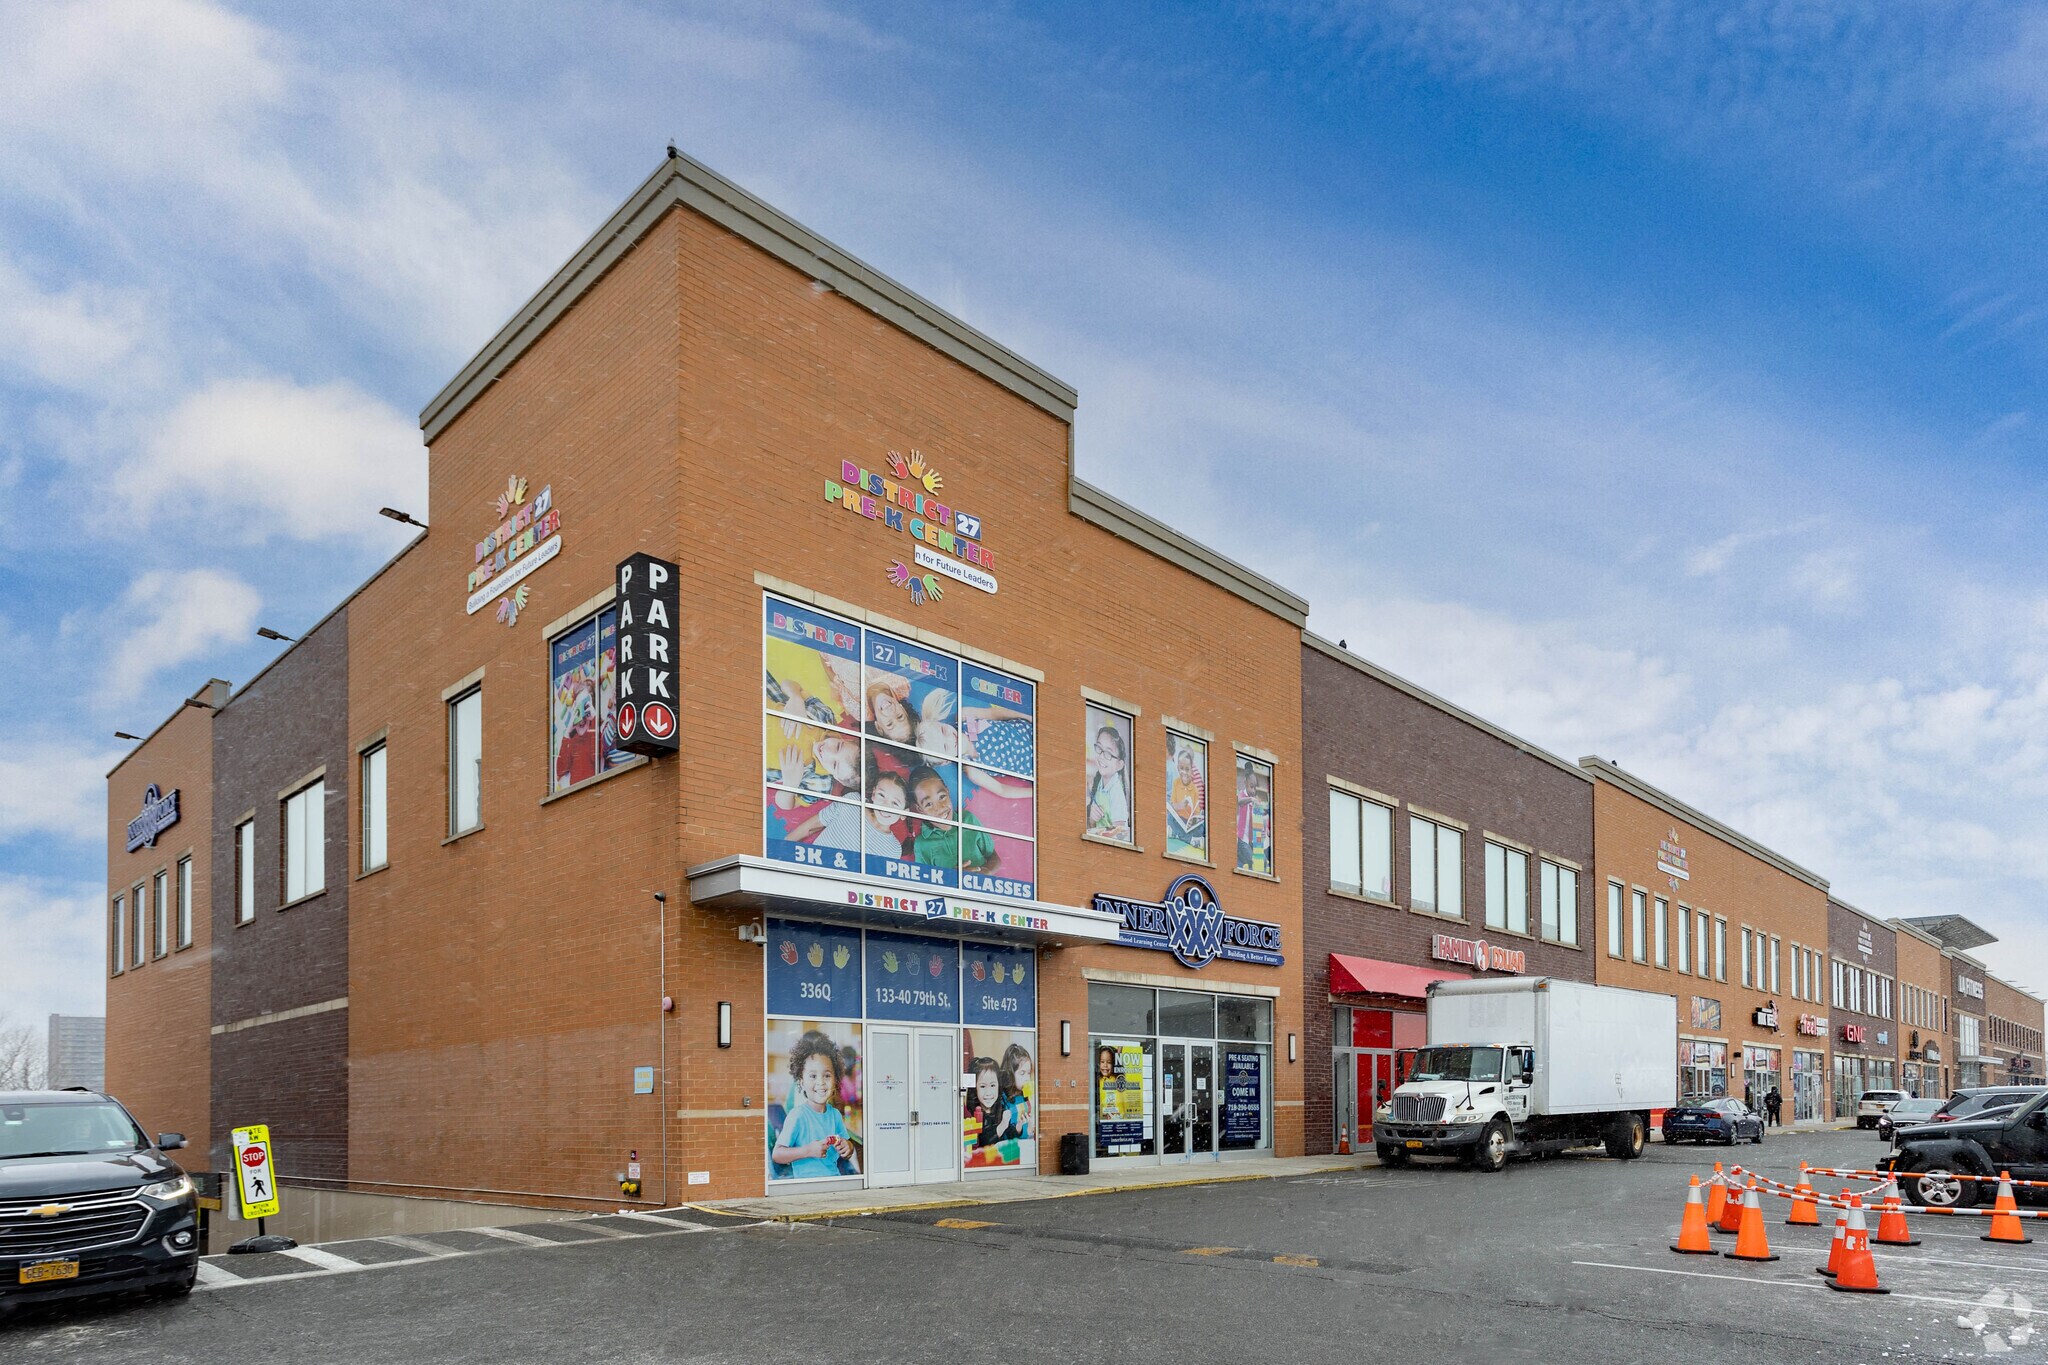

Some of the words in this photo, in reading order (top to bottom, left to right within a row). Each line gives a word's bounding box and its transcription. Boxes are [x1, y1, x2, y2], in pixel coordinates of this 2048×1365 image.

[842, 459, 950, 526] DISTRICT
[956, 513, 980, 537] 27
[475, 502, 533, 563] DISTRICT
[534, 487, 550, 518] 27
[824, 480, 904, 532] PRE-K
[909, 518, 995, 571] CENTER
[467, 547, 506, 592] PRE-K
[508, 509, 561, 561] CENTER
[923, 552, 934, 564] for
[936, 558, 962, 576] Future
[963, 569, 994, 589] Leaders
[620, 564, 634, 699] PARK
[646, 562, 670, 699] PARK
[774, 612, 855, 651] DISTRICT
[875, 645, 893, 662] 27
[900, 653, 948, 681] PRE-K
[970, 676, 1022, 704] CENTER
[794, 845, 823, 866] 3K
[833, 851, 848, 869] &
[963, 874, 1032, 898] CLASSES
[847, 891, 918, 912] DISTRICT
[927, 900, 944, 915] 27
[953, 906, 996, 923] PRE-K
[1002, 913, 1048, 930] CENTER
[1133, 936, 1153, 947] Learning
[1153, 940, 1168, 948] Center
[1224, 920, 1282, 950] FORCE
[1227, 950, 1246, 961] Building
[1250, 954, 1263, 962] Better
[1437, 934, 1476, 964] FAMILY
[1491, 946, 1525, 973] DOLLAR
[800, 982, 831, 1002] 336Q
[876, 987, 911, 1005] 133-40
[913, 990, 936, 1007] 79th
[982, 995, 999, 1011] Site
[1001, 997, 1018, 1012] 473
[1845, 1024, 1867, 1043] GNC
[1115, 1053, 1141, 1066] NOW
[1232, 1062, 1255, 1070] AVAILABLE
[1232, 1087, 1248, 1096] COME
[1249, 1087, 1256, 1096] IN
[243, 1151, 265, 1163] STOP
